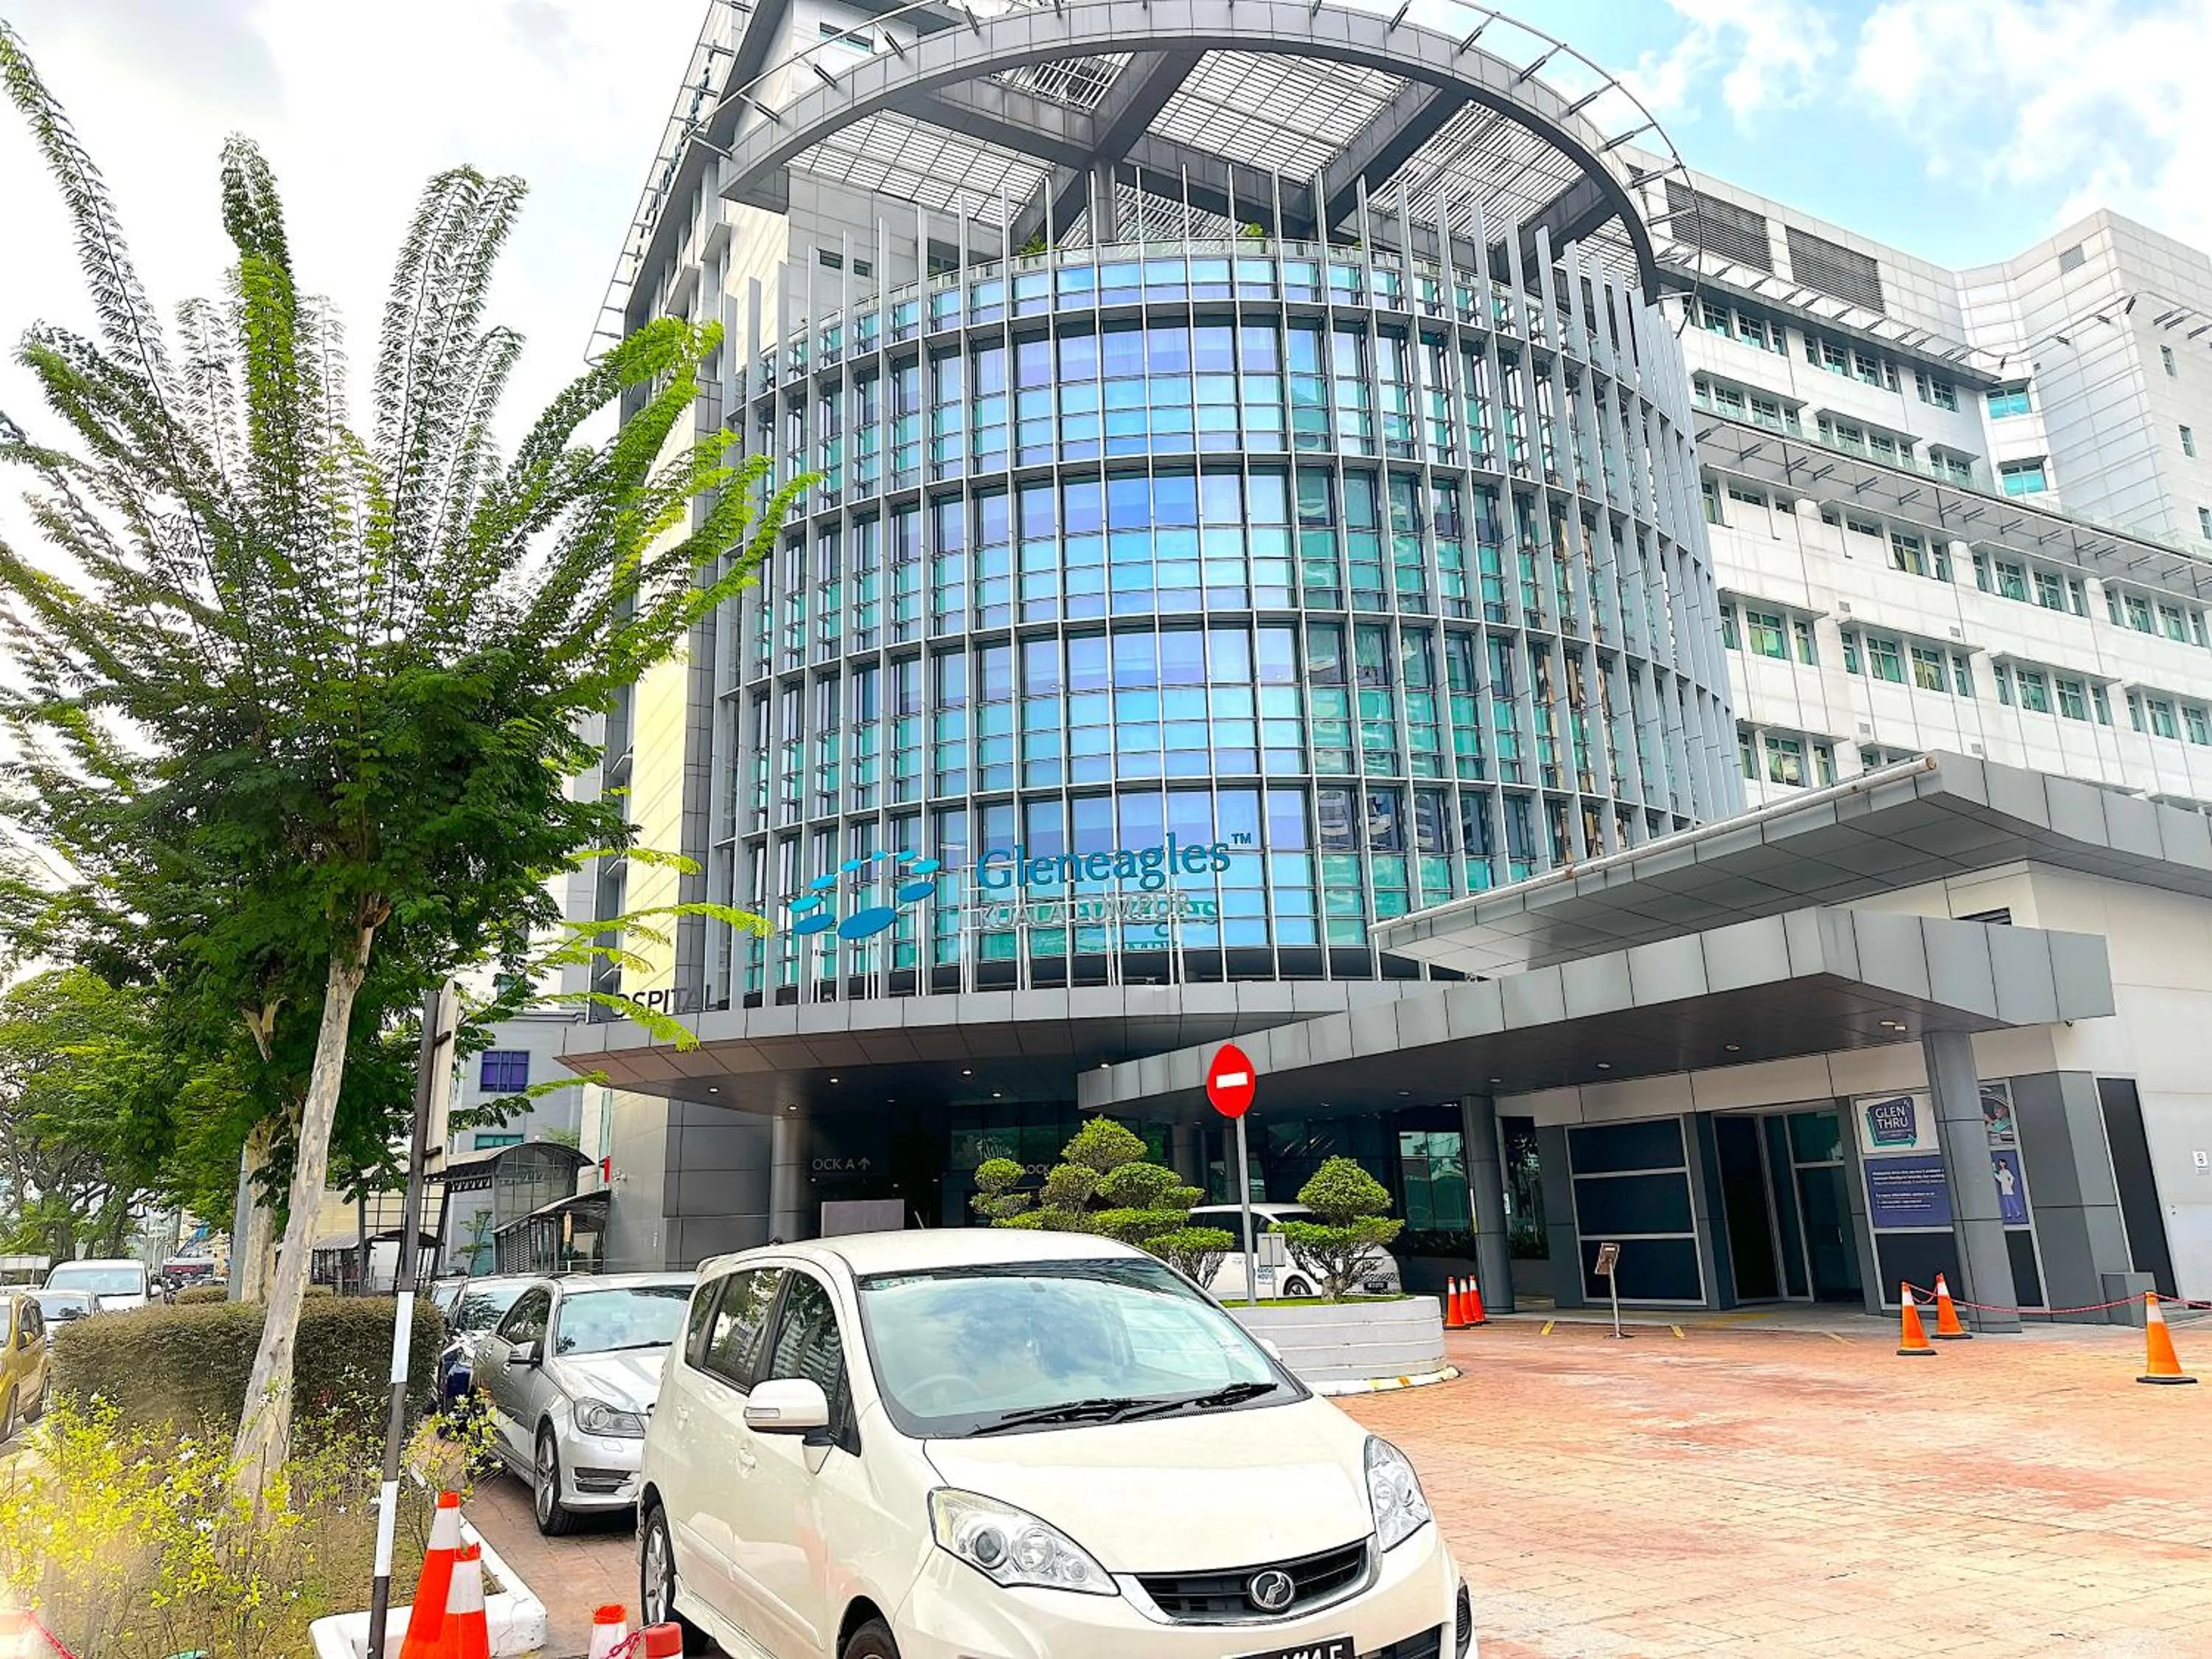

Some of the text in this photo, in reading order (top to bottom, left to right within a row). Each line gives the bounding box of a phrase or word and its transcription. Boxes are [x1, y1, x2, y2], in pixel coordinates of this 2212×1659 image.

[977, 832, 1231, 891] Gleneagles
[978, 892, 1190, 927] KUALA LUMPUR
[1875, 1106, 1905, 1119] GLEN
[1877, 1116, 1909, 1129] THRU
[812, 1158, 841, 1170] OCK
[1026, 1164, 1050, 1175] OCK
